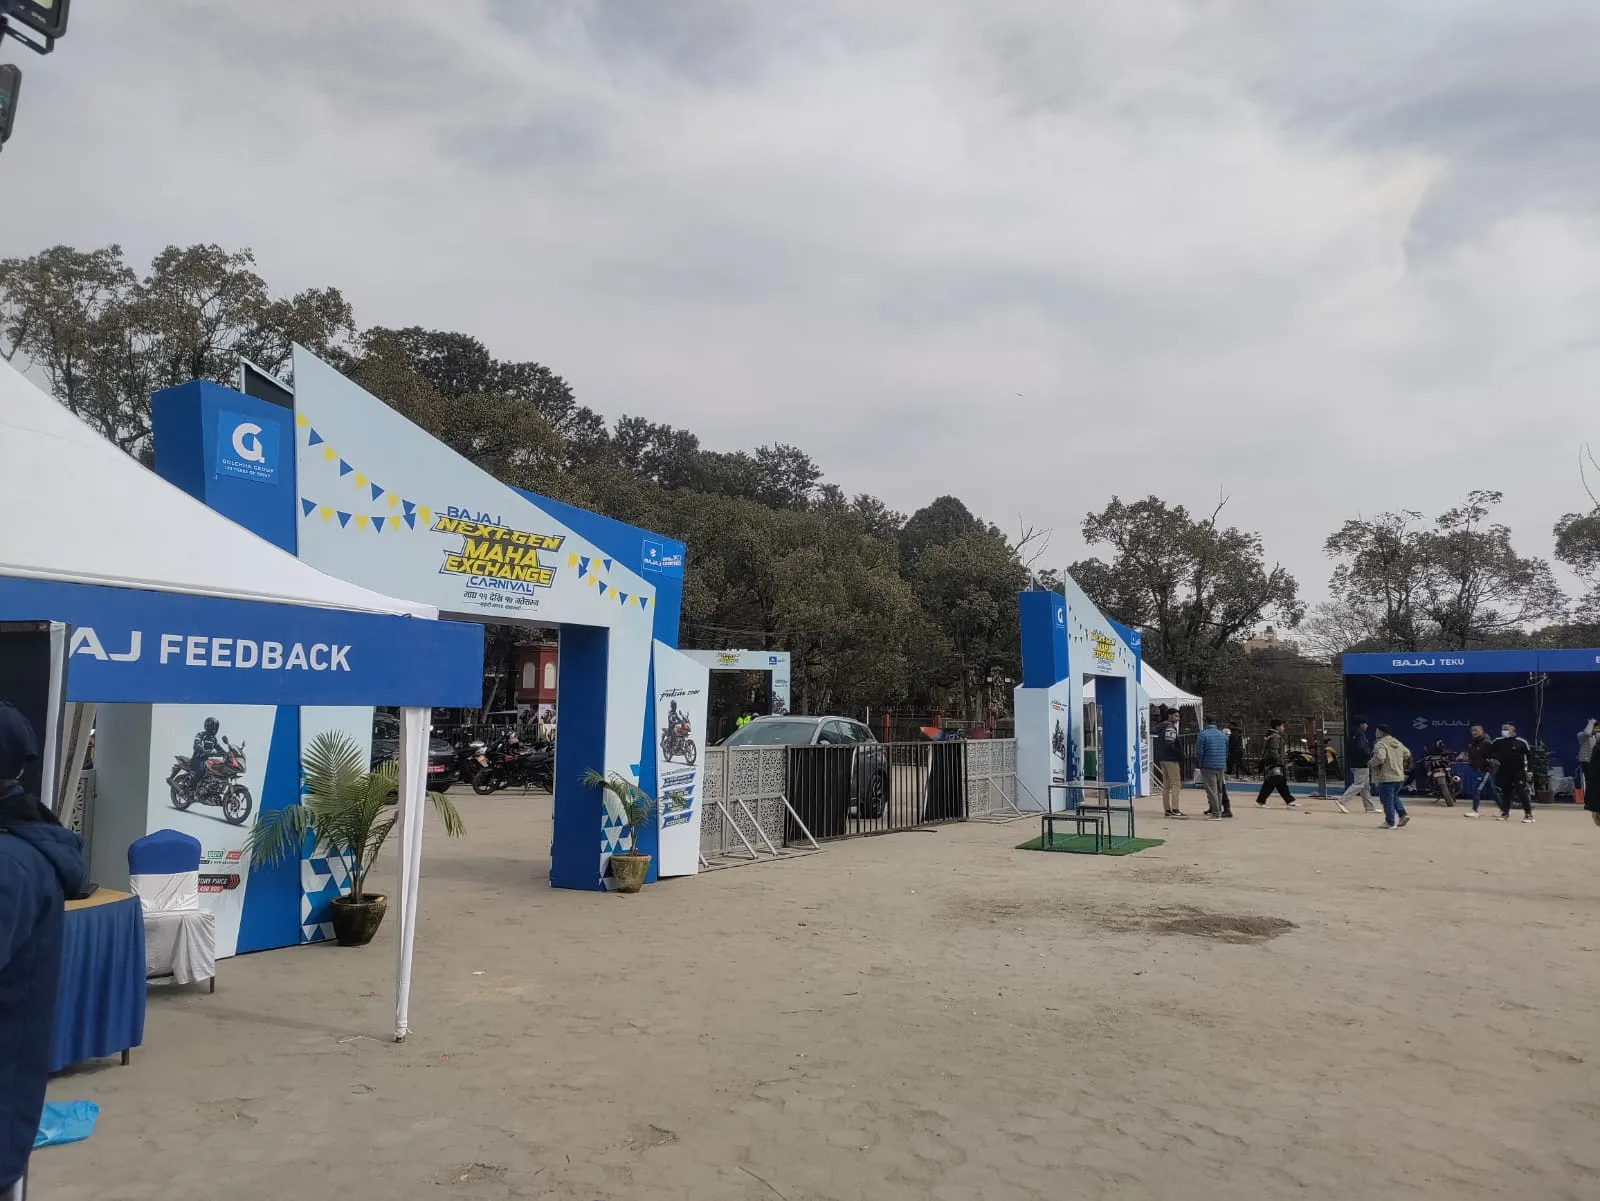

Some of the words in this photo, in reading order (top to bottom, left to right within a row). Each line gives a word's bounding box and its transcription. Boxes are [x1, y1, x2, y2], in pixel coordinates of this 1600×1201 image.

[447, 506, 501, 526] BAJAJ
[436, 517, 561, 549] NEXT-GEN
[462, 538, 538, 567] MAHA
[444, 555, 553, 585] EXCHANGE
[470, 576, 532, 592] CARNIVAL
[69, 627, 141, 661] AJ
[160, 633, 352, 671] FEEDBACK
